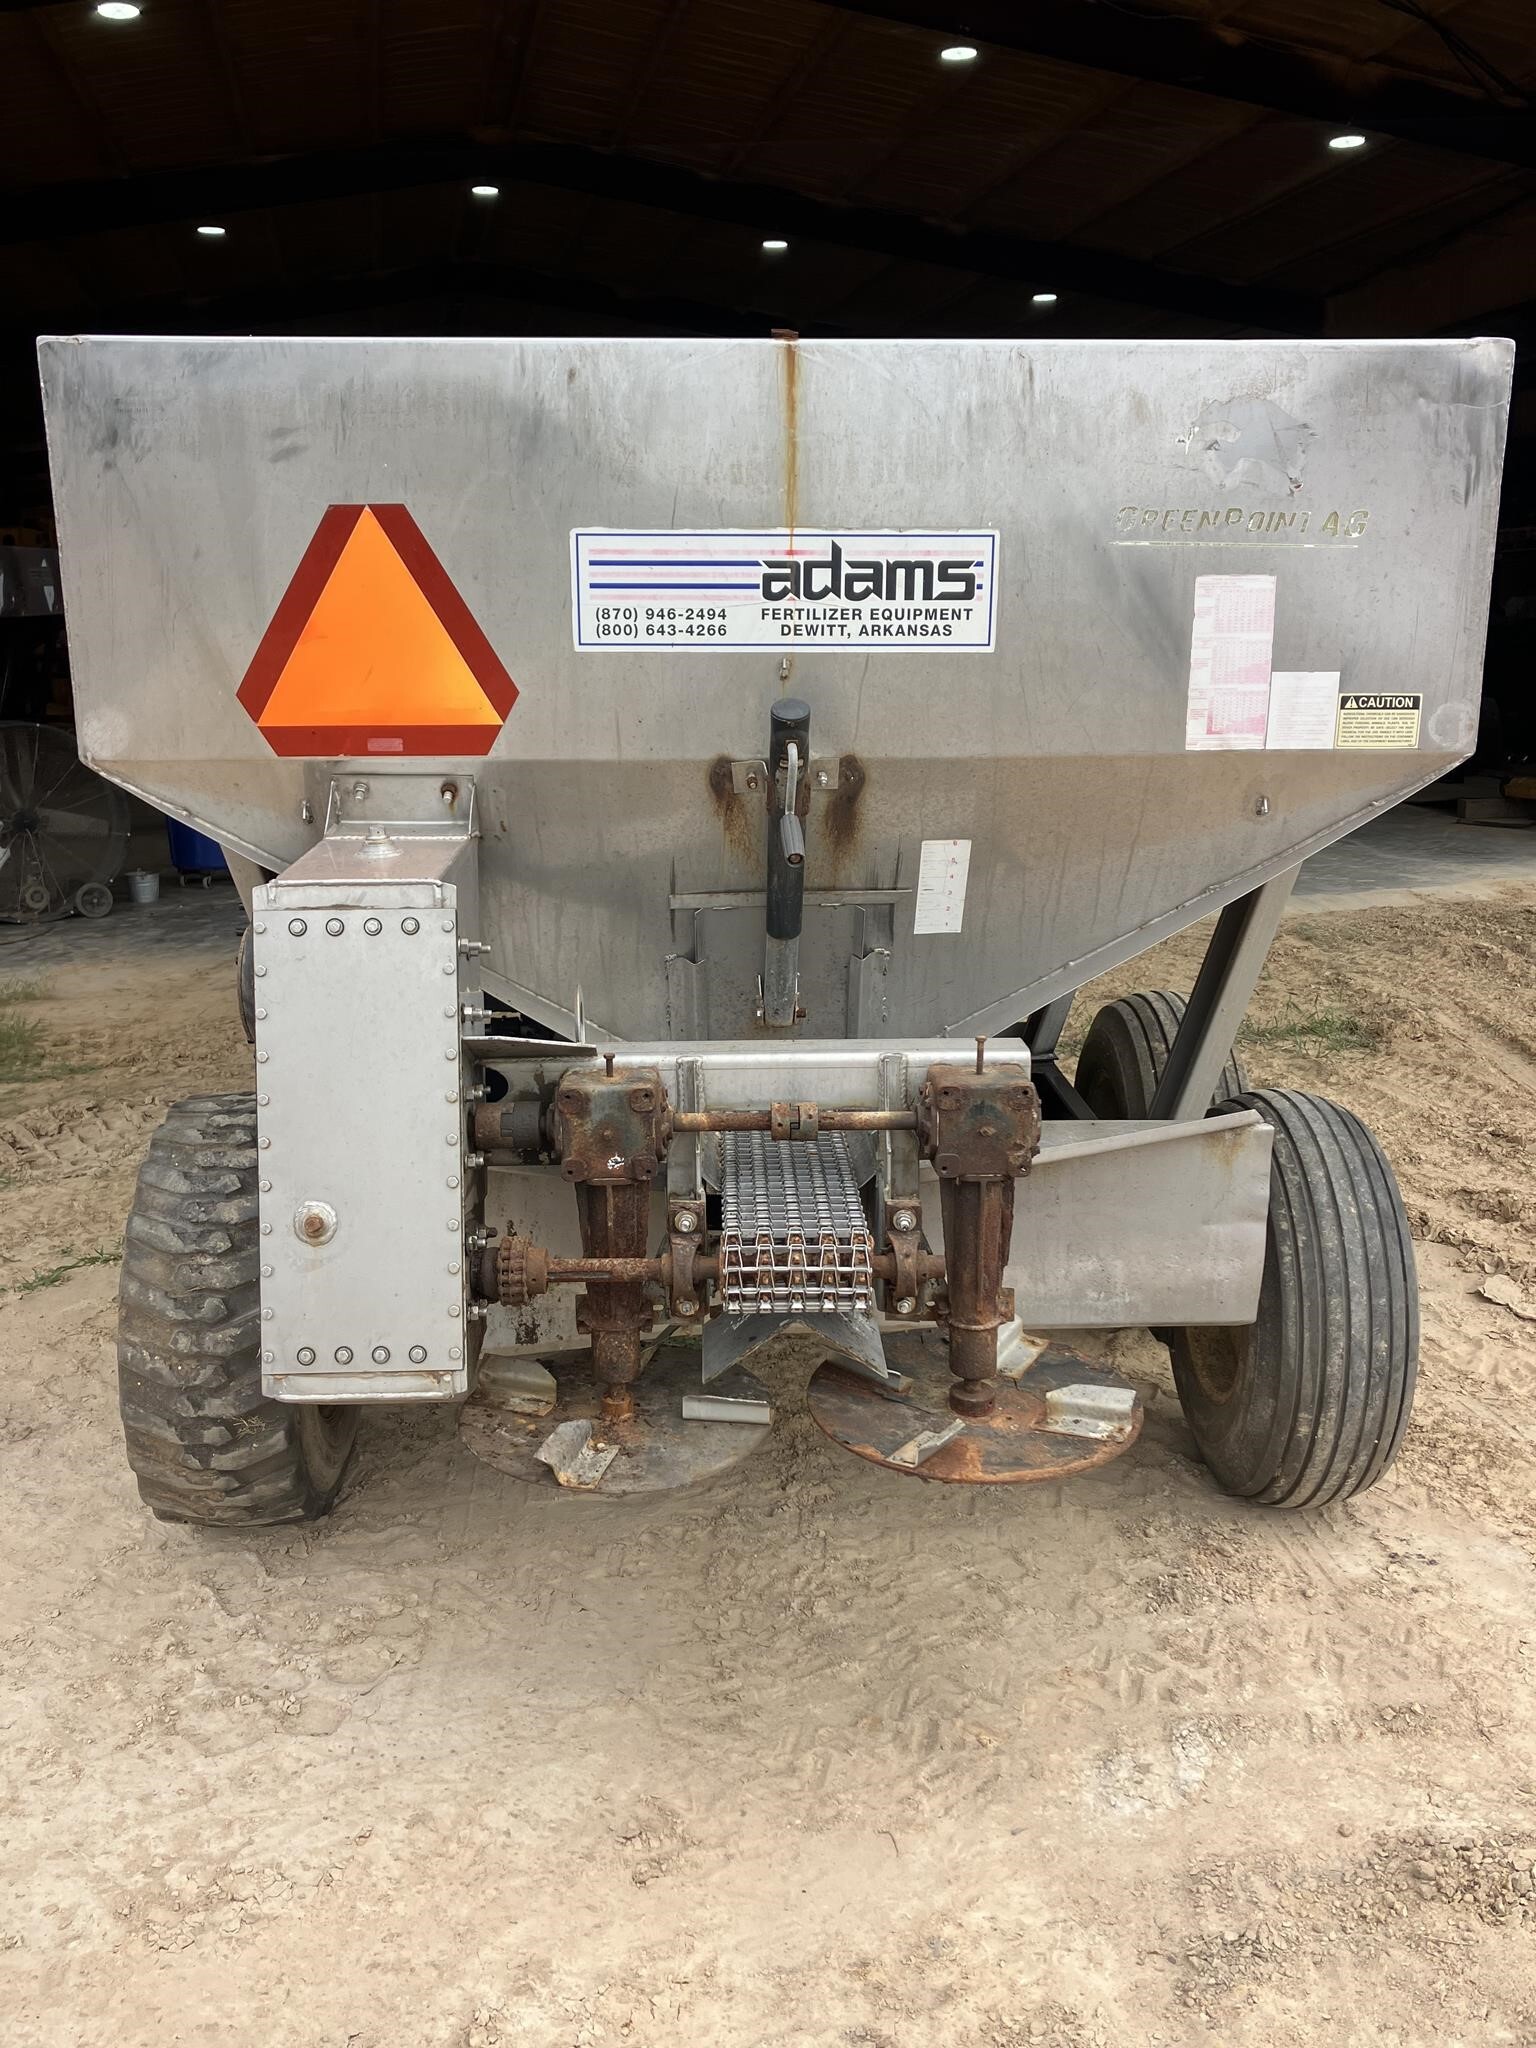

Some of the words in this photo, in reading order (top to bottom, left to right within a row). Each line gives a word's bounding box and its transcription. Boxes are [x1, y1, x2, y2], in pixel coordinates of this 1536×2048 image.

[1322, 509, 1369, 538] AG
[761, 538, 977, 601] adams
[595, 607, 639, 622] (870)
[645, 607, 727, 622] 946-2494
[760, 607, 863, 622] FERTILIZER
[869, 607, 974, 622] EQUIPMENT
[596, 622, 639, 638] (800)
[645, 623, 727, 637] 643-4266
[780, 623, 853, 639] DEWITT,
[858, 623, 953, 637] ARKANSAS
[1358, 696, 1414, 708] CAUTION
